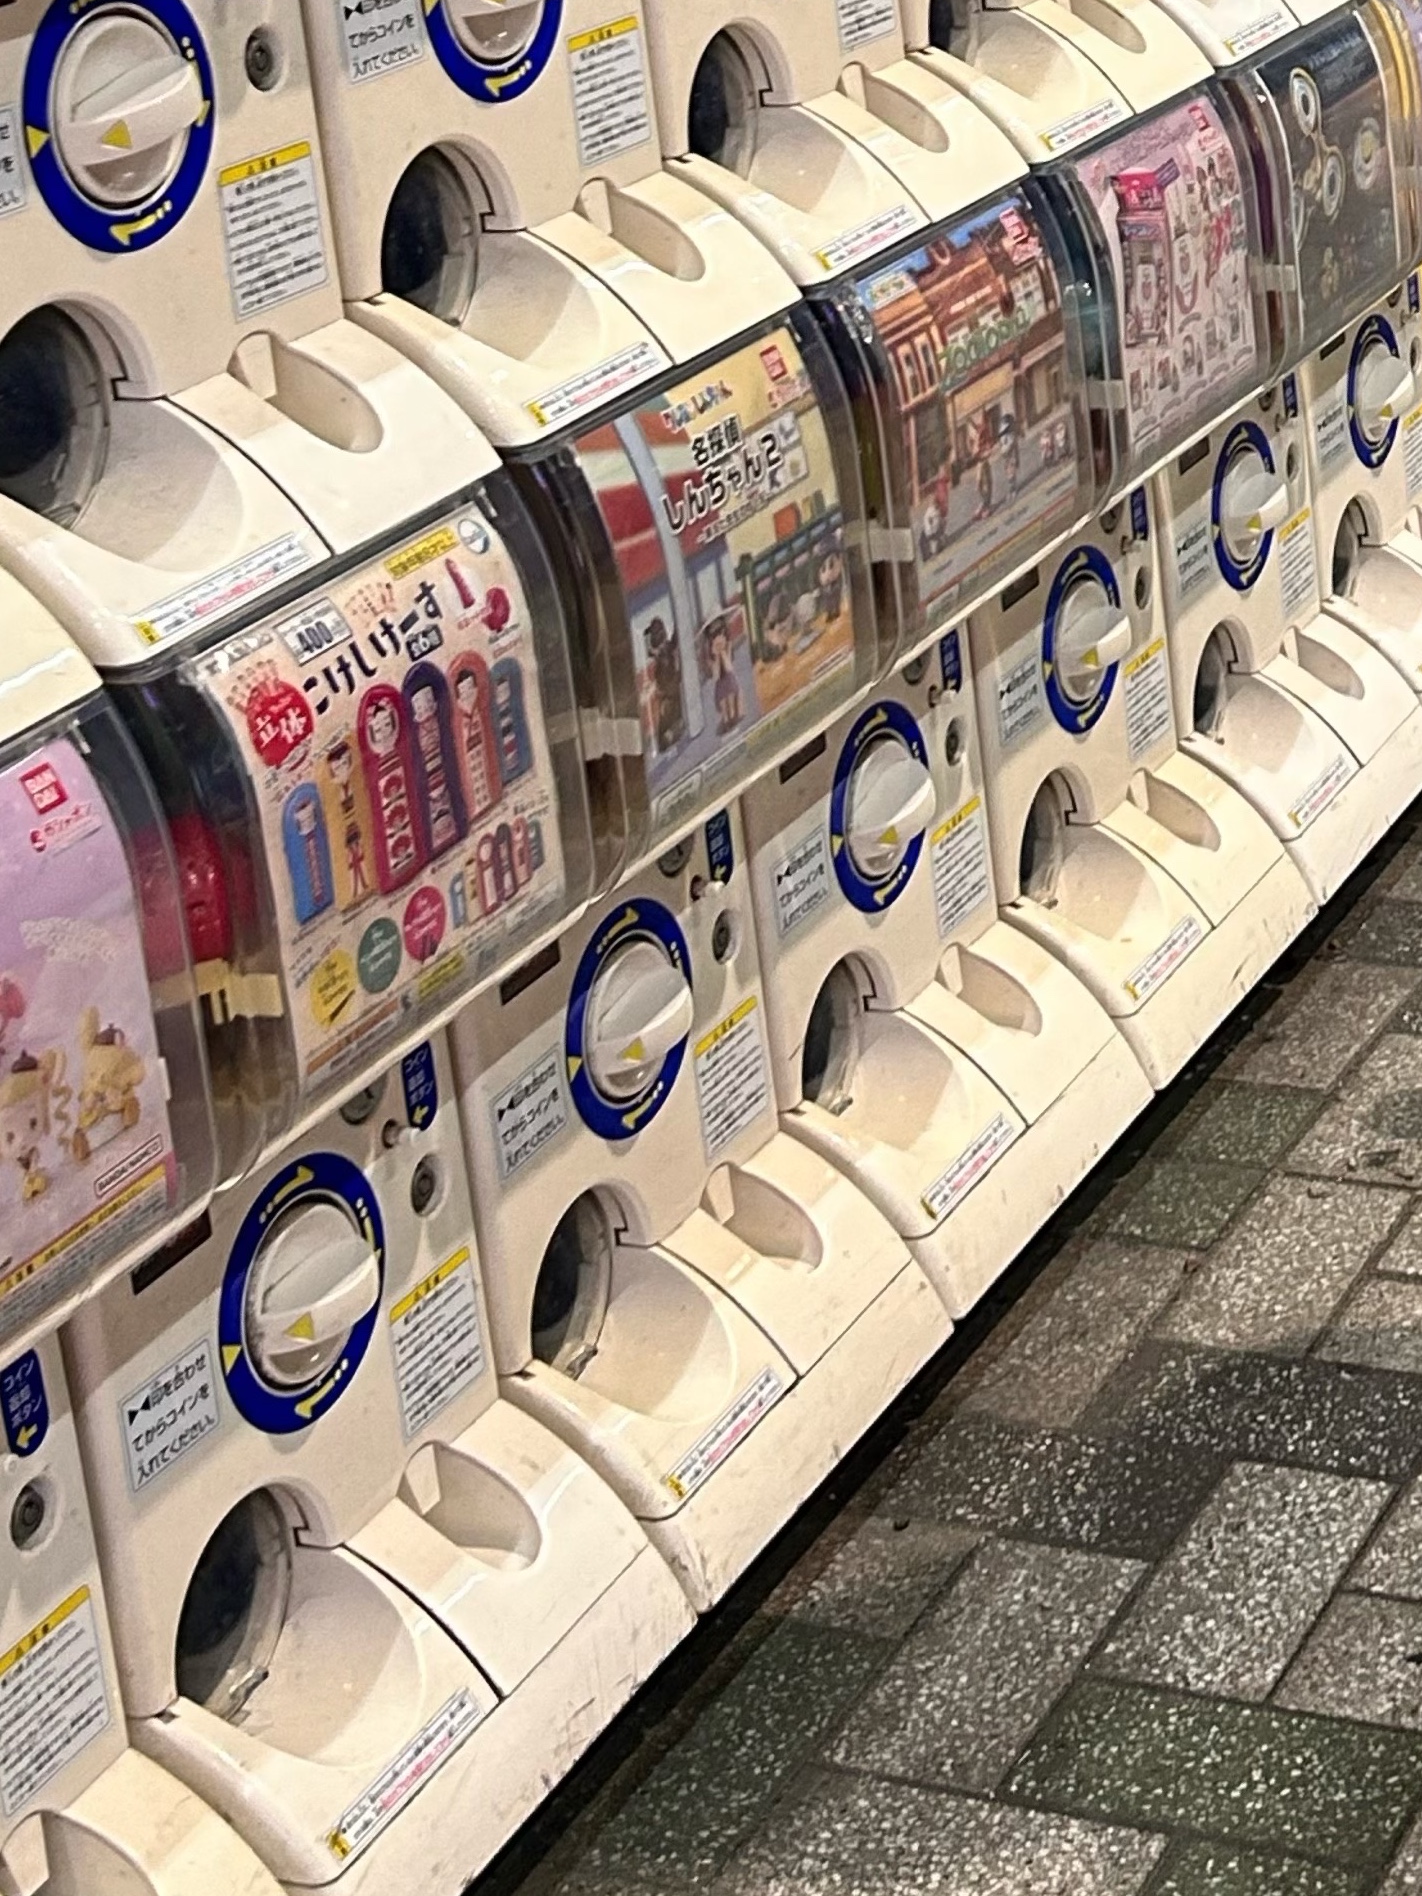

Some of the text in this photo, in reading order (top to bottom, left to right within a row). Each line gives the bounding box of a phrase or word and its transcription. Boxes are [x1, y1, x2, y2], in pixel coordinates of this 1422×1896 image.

[690, 415, 741, 468] 名探偵
[255, 705, 307, 749] 立体
[131, 1382, 210, 1453] てからコインを
